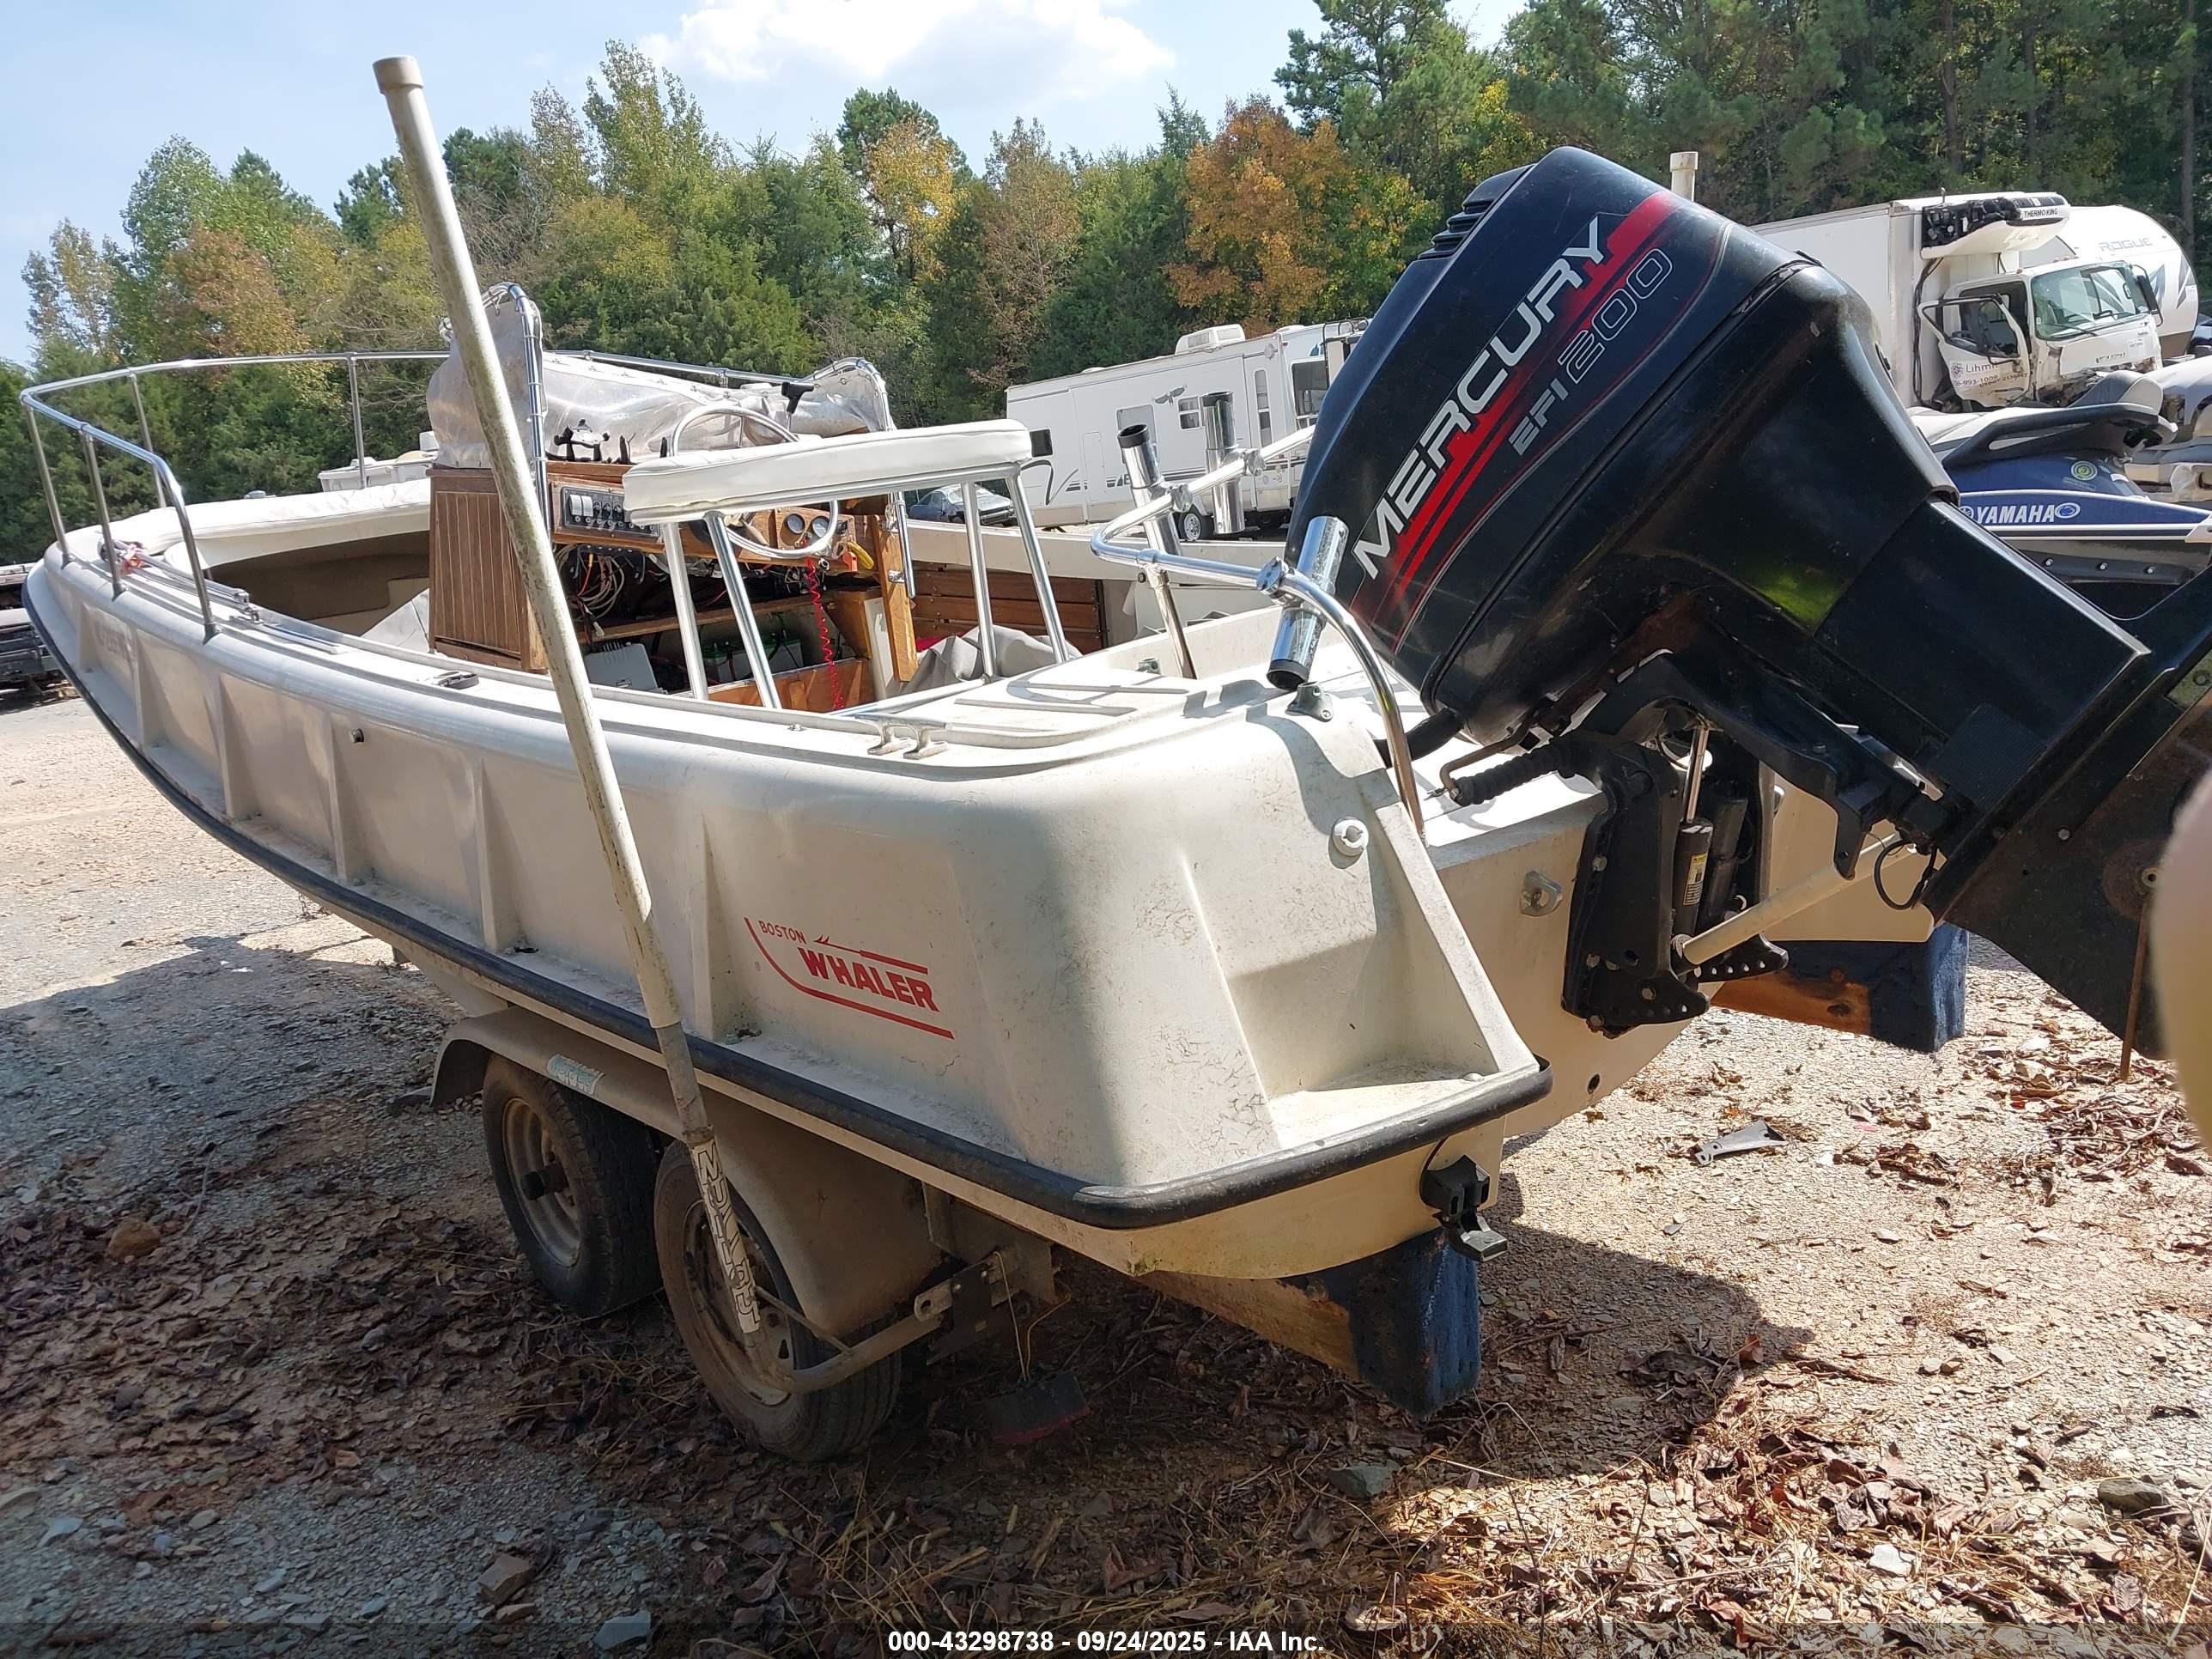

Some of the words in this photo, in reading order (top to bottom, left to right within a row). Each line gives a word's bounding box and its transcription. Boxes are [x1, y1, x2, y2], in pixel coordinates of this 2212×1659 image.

[2024, 209, 2045, 218] THERMO
[2046, 207, 2058, 216] KING
[2098, 238, 2154, 252] ROGUE
[1507, 377, 1569, 456] EFI
[1557, 247, 1673, 385] 200
[1352, 215, 1605, 580] MERCURY
[1977, 504, 2055, 524] YAMAHA
[758, 920, 806, 944] BOSTON
[797, 946, 940, 1012] WHALER
